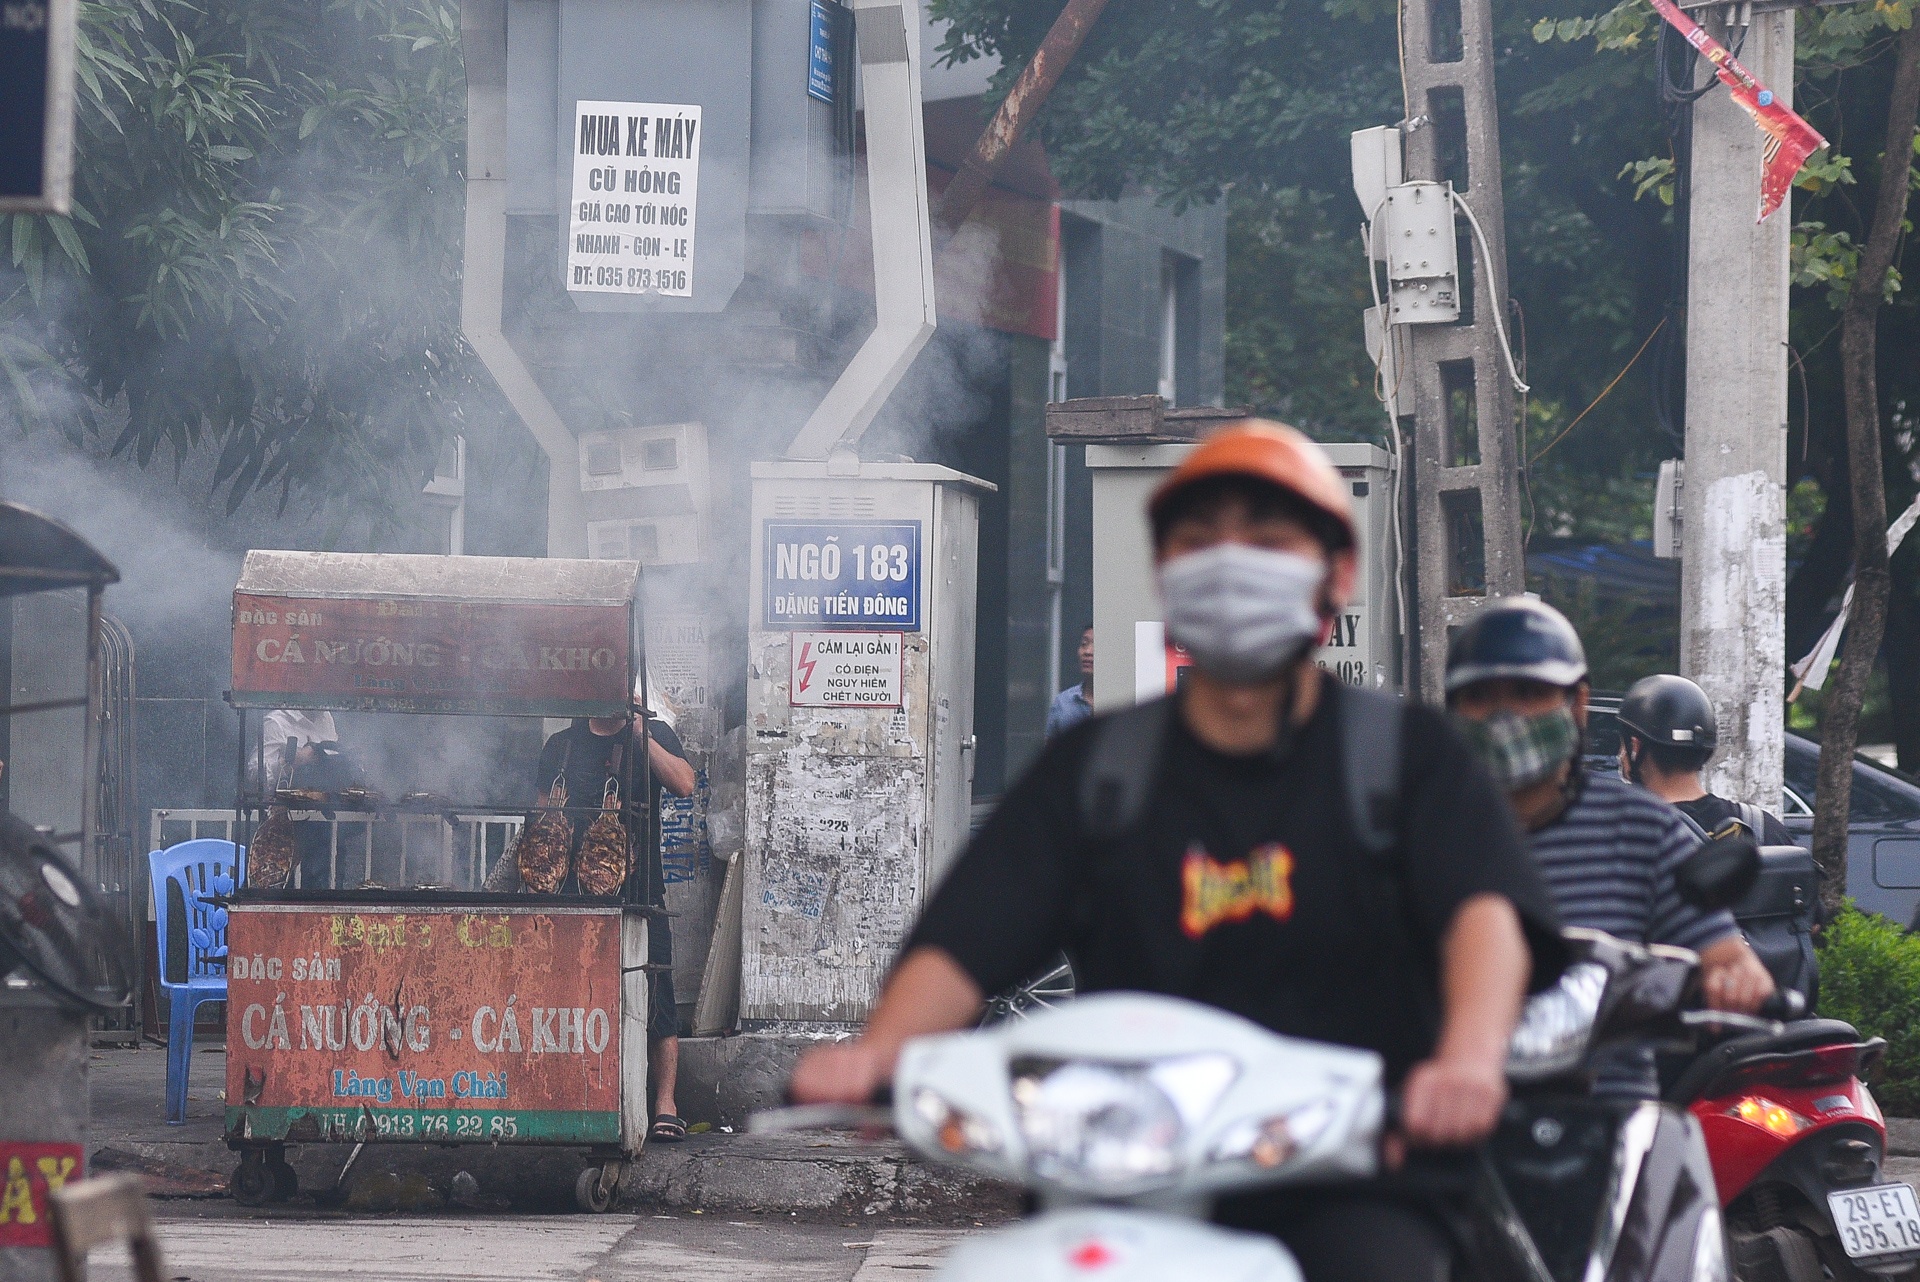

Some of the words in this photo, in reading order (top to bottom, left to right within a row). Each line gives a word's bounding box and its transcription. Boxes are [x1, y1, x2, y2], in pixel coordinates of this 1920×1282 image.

[579, 114, 620, 156] MUA
[625, 116, 649, 158] XE
[654, 112, 697, 160] MÁY
[589, 165, 617, 192] CŨ
[624, 165, 681, 195] HỎNG
[579, 199, 601, 222] GIÁ
[605, 203, 631, 223] CAO
[635, 201, 656, 225] TỚI
[660, 203, 688, 227] NÓC
[576, 233, 621, 255] NHANH
[633, 236, 661, 260] GỌN
[673, 238, 687, 262] LẸ
[573, 265, 593, 286] ĐT:
[596, 266, 623, 287] 035
[627, 267, 652, 289] 873
[656, 269, 687, 290] 1516
[775, 535, 841, 581] NGÕ
[852, 544, 909, 582] 183
[775, 592, 819, 619] ĐẶNG
[823, 589, 859, 616] TIẾN
[863, 592, 909, 617] ĐÔNG
[256, 633, 308, 665] CÁ
[313, 635, 443, 669] NƯỚNG
[537, 645, 618, 672] KHO
[846, 642, 864, 658] LẠI
[827, 678, 858, 688] NGUY
[835, 663, 852, 674] CÓ
[854, 664, 880, 677] ĐIỆN
[854, 690, 891, 702] NGƯỜI
[231, 953, 283, 985] ĐẶC
[291, 951, 342, 982] SẢN
[241, 991, 292, 1051] CÁ
[299, 992, 431, 1053] NƯỚNG
[471, 993, 523, 1053] CÁ
[530, 1006, 611, 1054] KHO
[332, 1069, 394, 1104] Làng
[397, 1070, 446, 1104] Vạn
[451, 1070, 509, 1100] Chài
[421, 1114, 449, 1138] 76
[456, 1114, 484, 1138] 22
[490, 1115, 519, 1139] 85
[1842, 1190, 1907, 1223] 29-E1
[1845, 1218, 1920, 1253] 355.18
